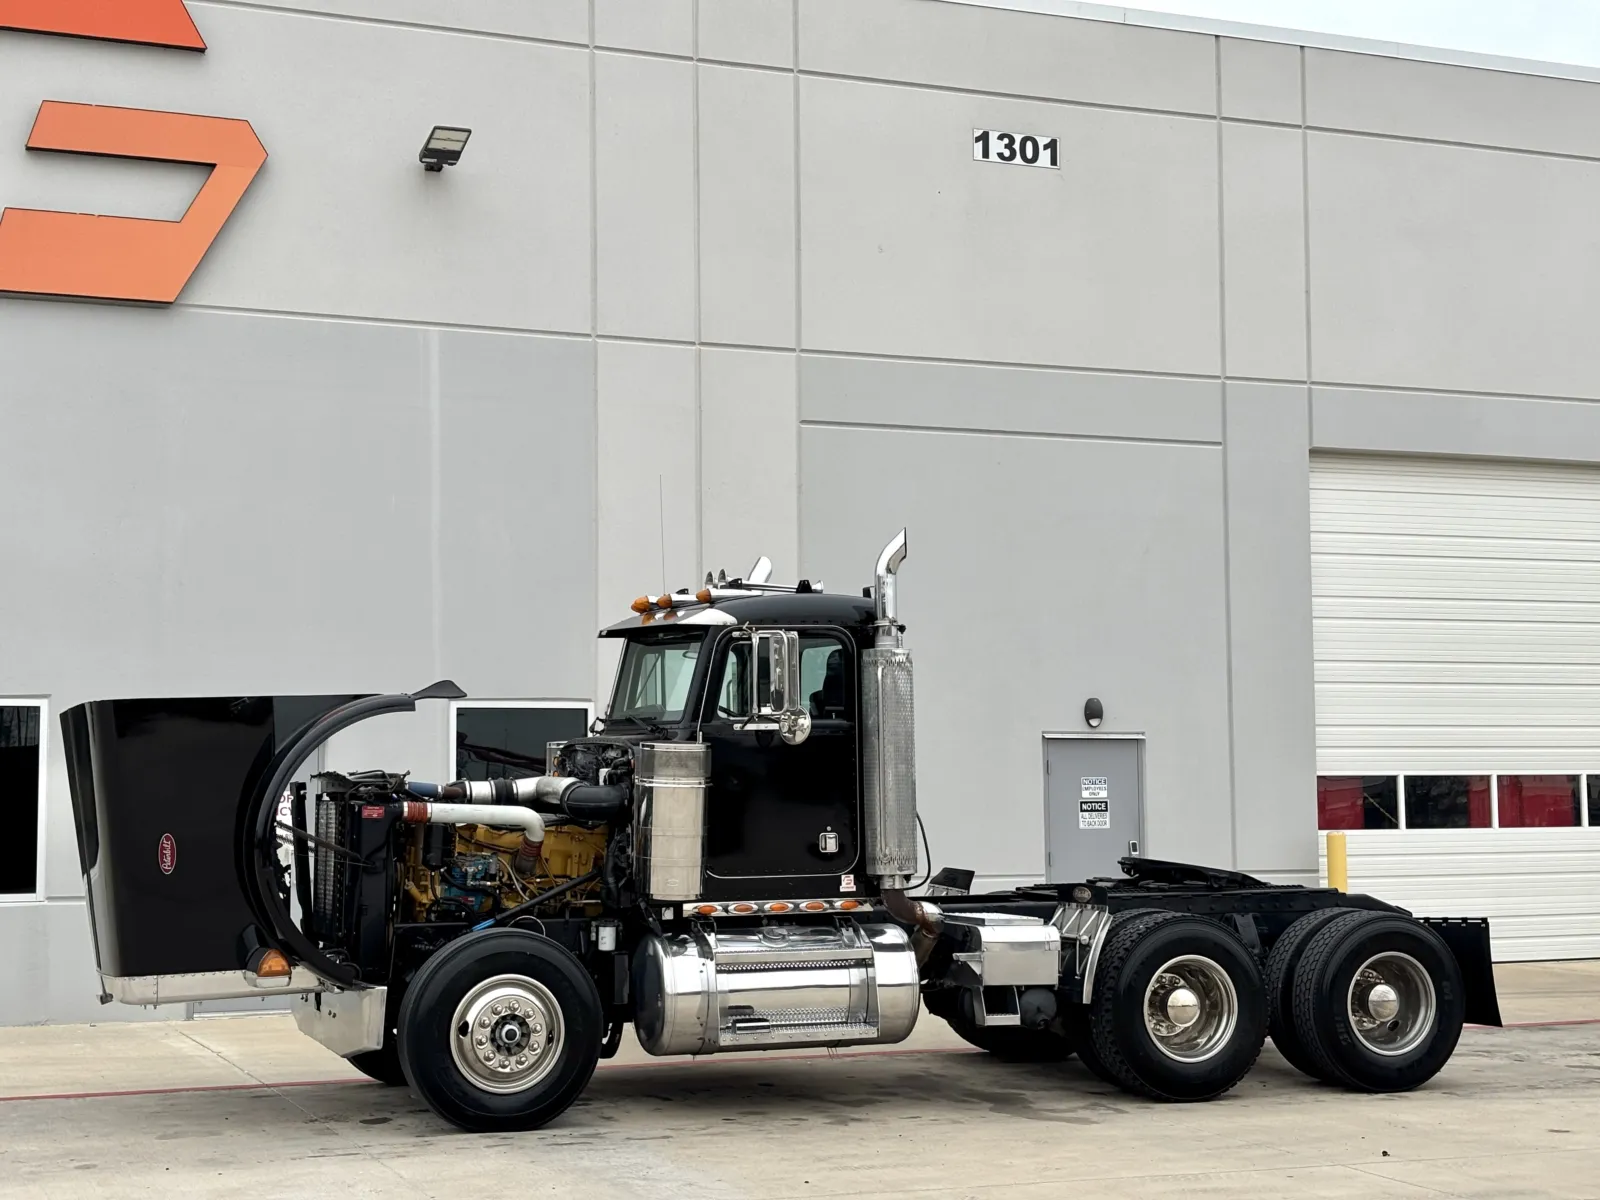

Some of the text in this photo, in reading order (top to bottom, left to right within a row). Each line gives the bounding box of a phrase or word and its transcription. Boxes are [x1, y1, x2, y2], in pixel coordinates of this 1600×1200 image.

[975, 130, 1058, 167] 1301
[1082, 803, 1106, 811] NOTICE
[161, 837, 172, 870] Peterbilt
